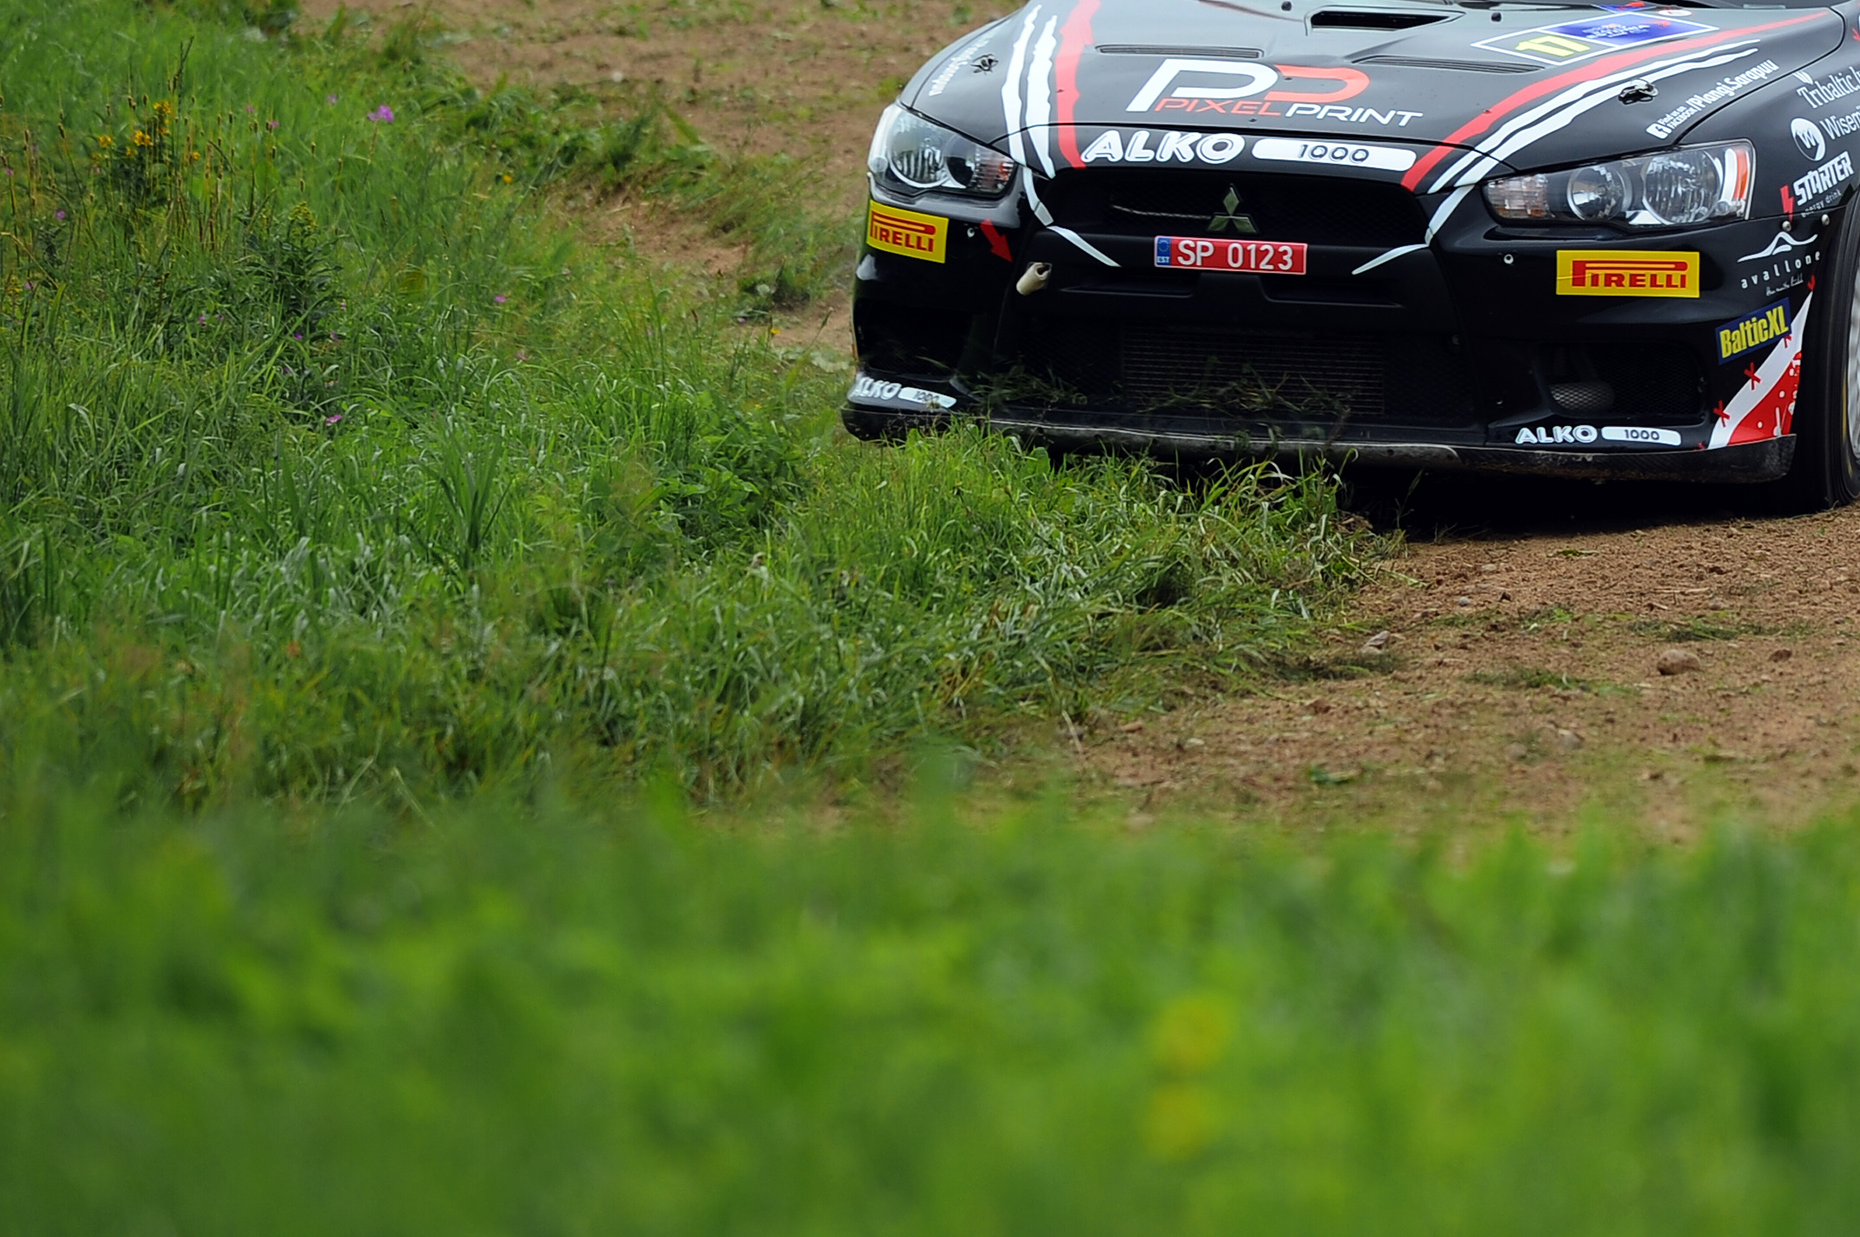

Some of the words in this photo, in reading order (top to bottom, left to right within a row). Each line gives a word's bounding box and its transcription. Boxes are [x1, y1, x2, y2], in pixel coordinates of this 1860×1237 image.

[1515, 35, 1591, 58] 17
[1080, 129, 1246, 165] ALKO
[1299, 143, 1370, 163] 1000
[1793, 151, 1854, 206] STARTER
[869, 210, 936, 252] PIRELLI
[1177, 239, 1215, 266] SP
[1227, 242, 1293, 271] 0123
[1741, 251, 1821, 289] avallone
[1572, 260, 1688, 289] PIRELLI
[1720, 305, 1789, 359] BalticXL
[1515, 424, 1598, 444] ALKO
[1624, 429, 1660, 441] 1000
